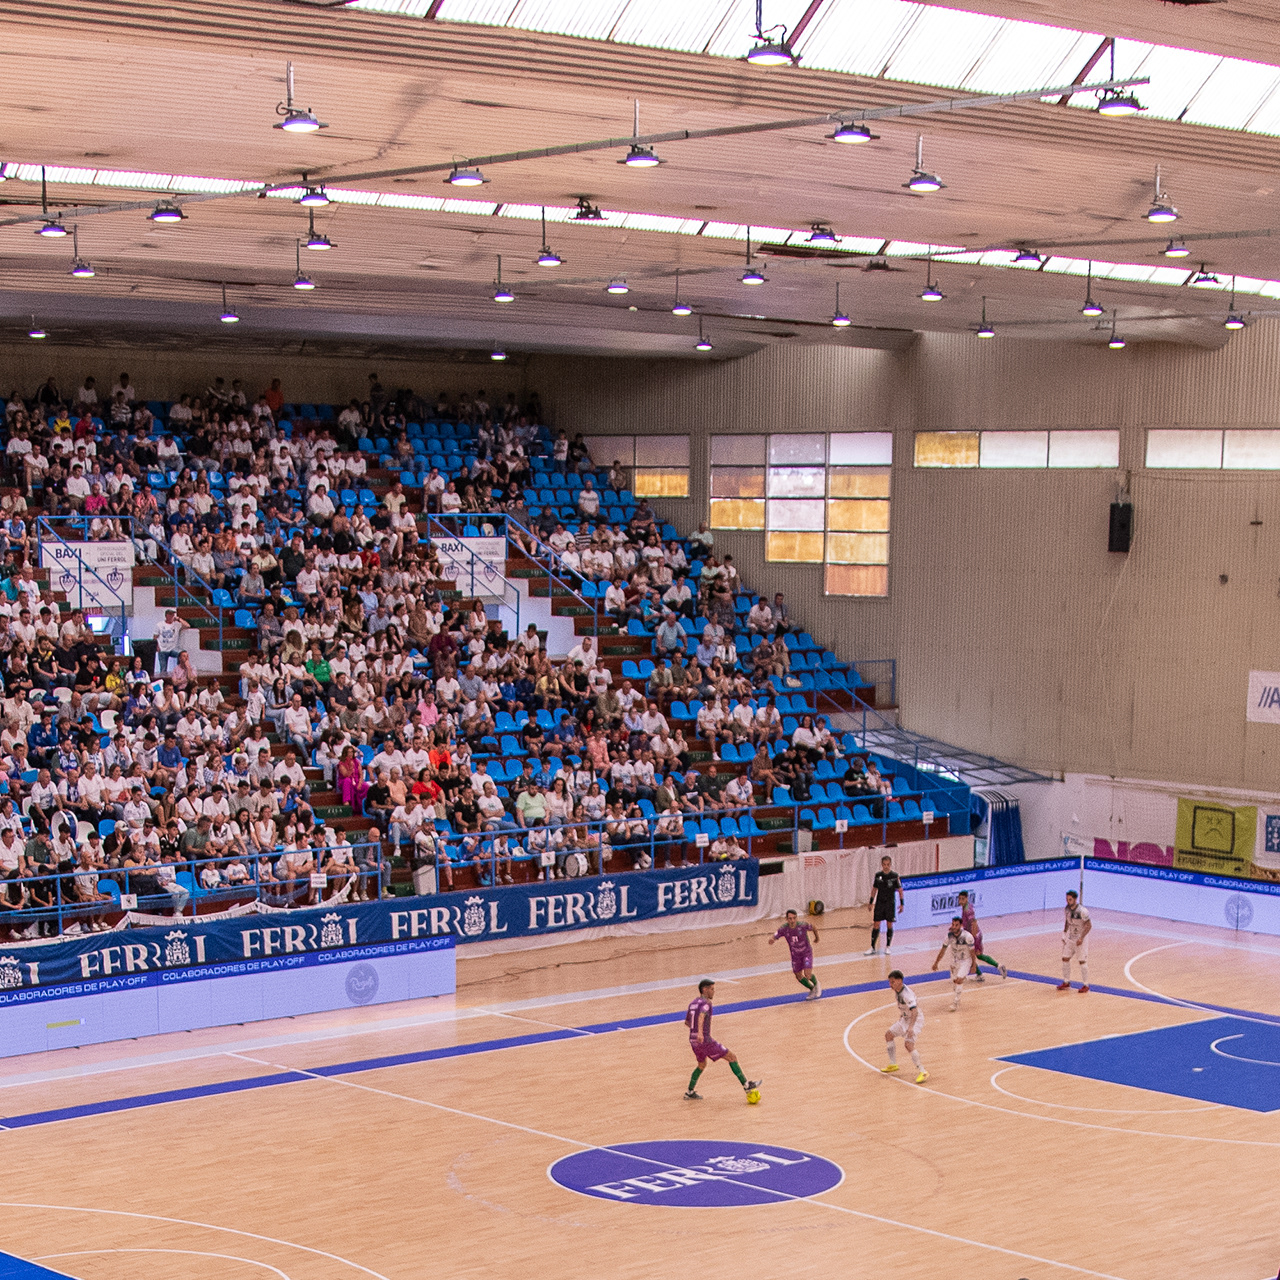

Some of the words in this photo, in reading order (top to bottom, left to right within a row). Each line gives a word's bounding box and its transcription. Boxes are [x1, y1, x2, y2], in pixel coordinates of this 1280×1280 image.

[56, 548, 82, 558] BAXI
[1087, 861, 1148, 875] COLABORADORES
[1204, 877, 1269, 891] COLABORADORES
[1270, 886, 1280, 894] DE
[318, 946, 395, 962] COLABORADORES
[396, 944, 407, 954] DE
[162, 964, 246, 981] COLABORADORES
[247, 962, 259, 972] DE
[84, 981, 97, 991] DE
